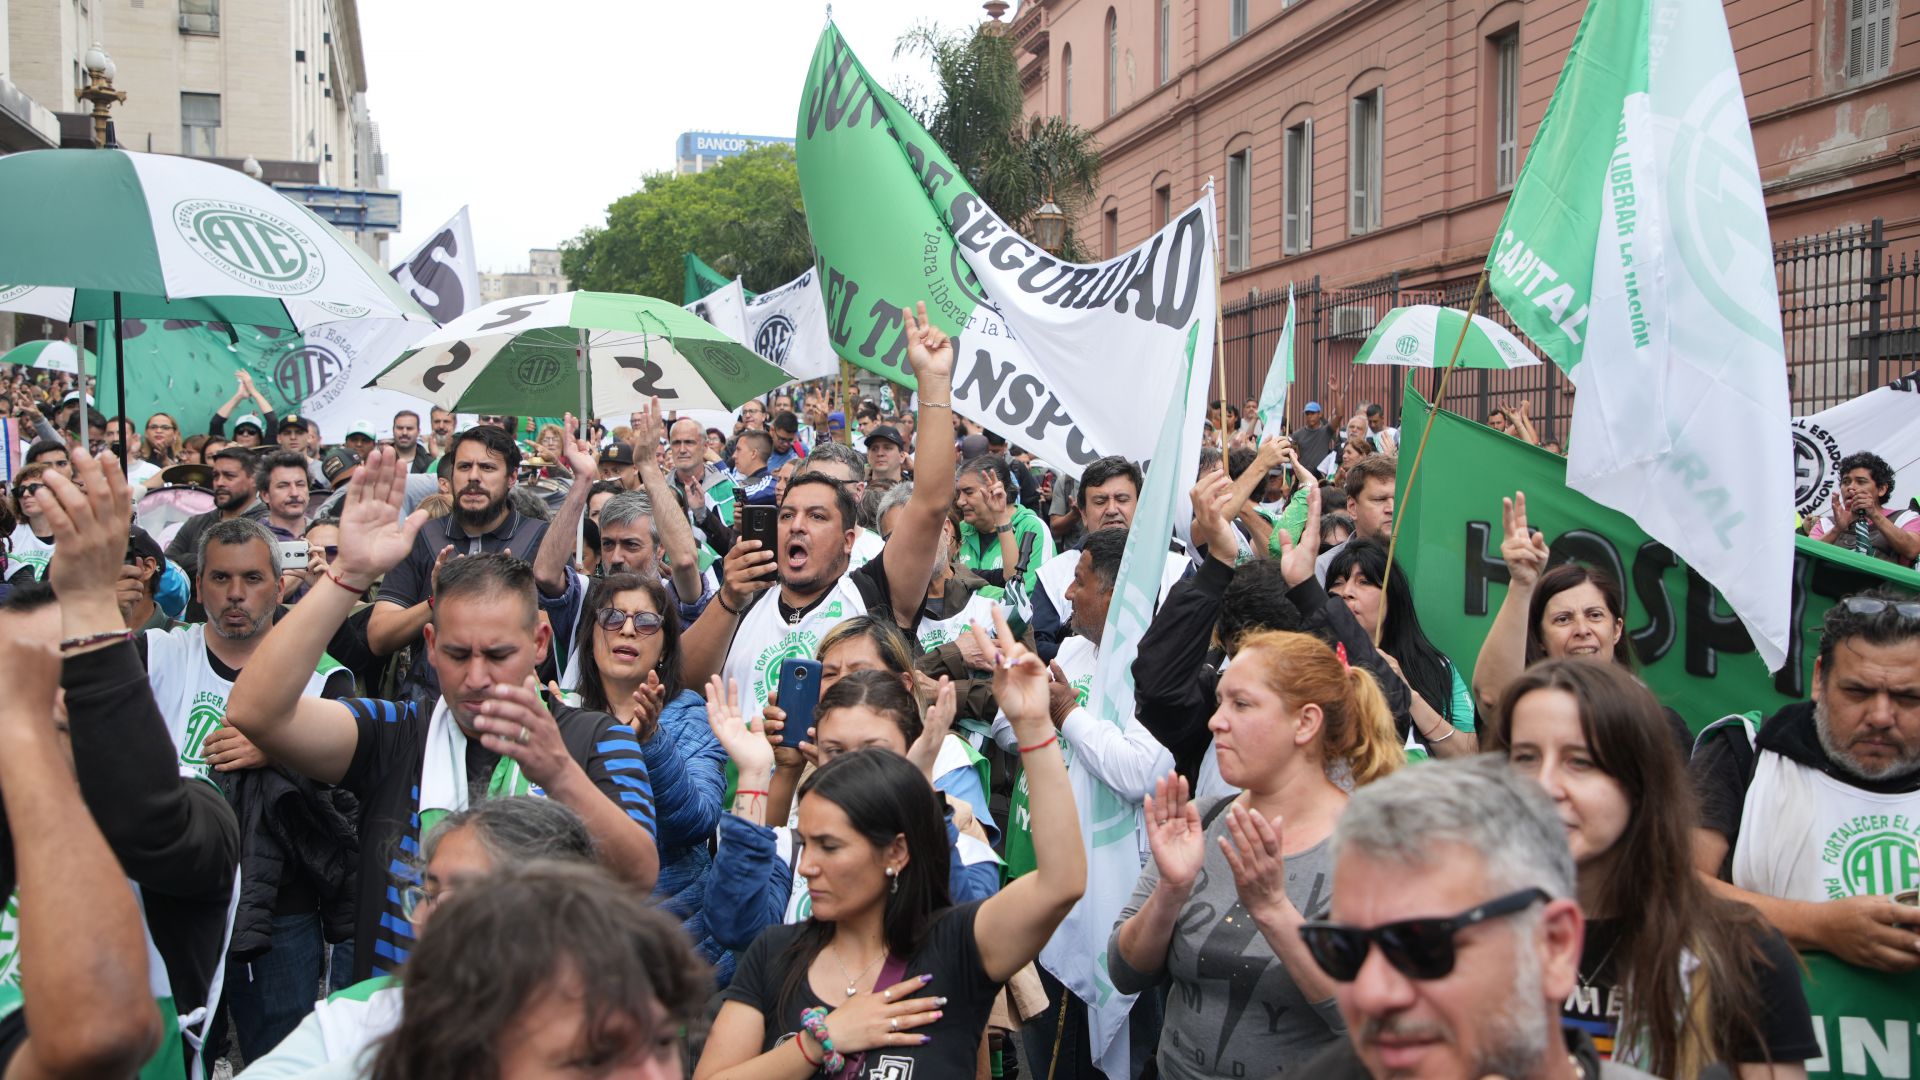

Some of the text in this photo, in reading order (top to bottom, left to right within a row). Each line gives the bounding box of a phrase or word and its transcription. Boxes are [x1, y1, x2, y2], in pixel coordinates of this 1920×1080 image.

[203, 214, 299, 275] ATE
[259, 212, 309, 245] PUEBLO
[203, 251, 247, 280] CIUDAD
[249, 276, 265, 287] DE
[924, 231, 999, 337] para liberar la
[943, 190, 1206, 331] SEGURIDAD
[1494, 229, 1589, 345] CAPITAL
[280, 350, 335, 403] ATE
[1822, 815, 1889, 865] FORTALECER
[1893, 815, 1909, 831] EL
